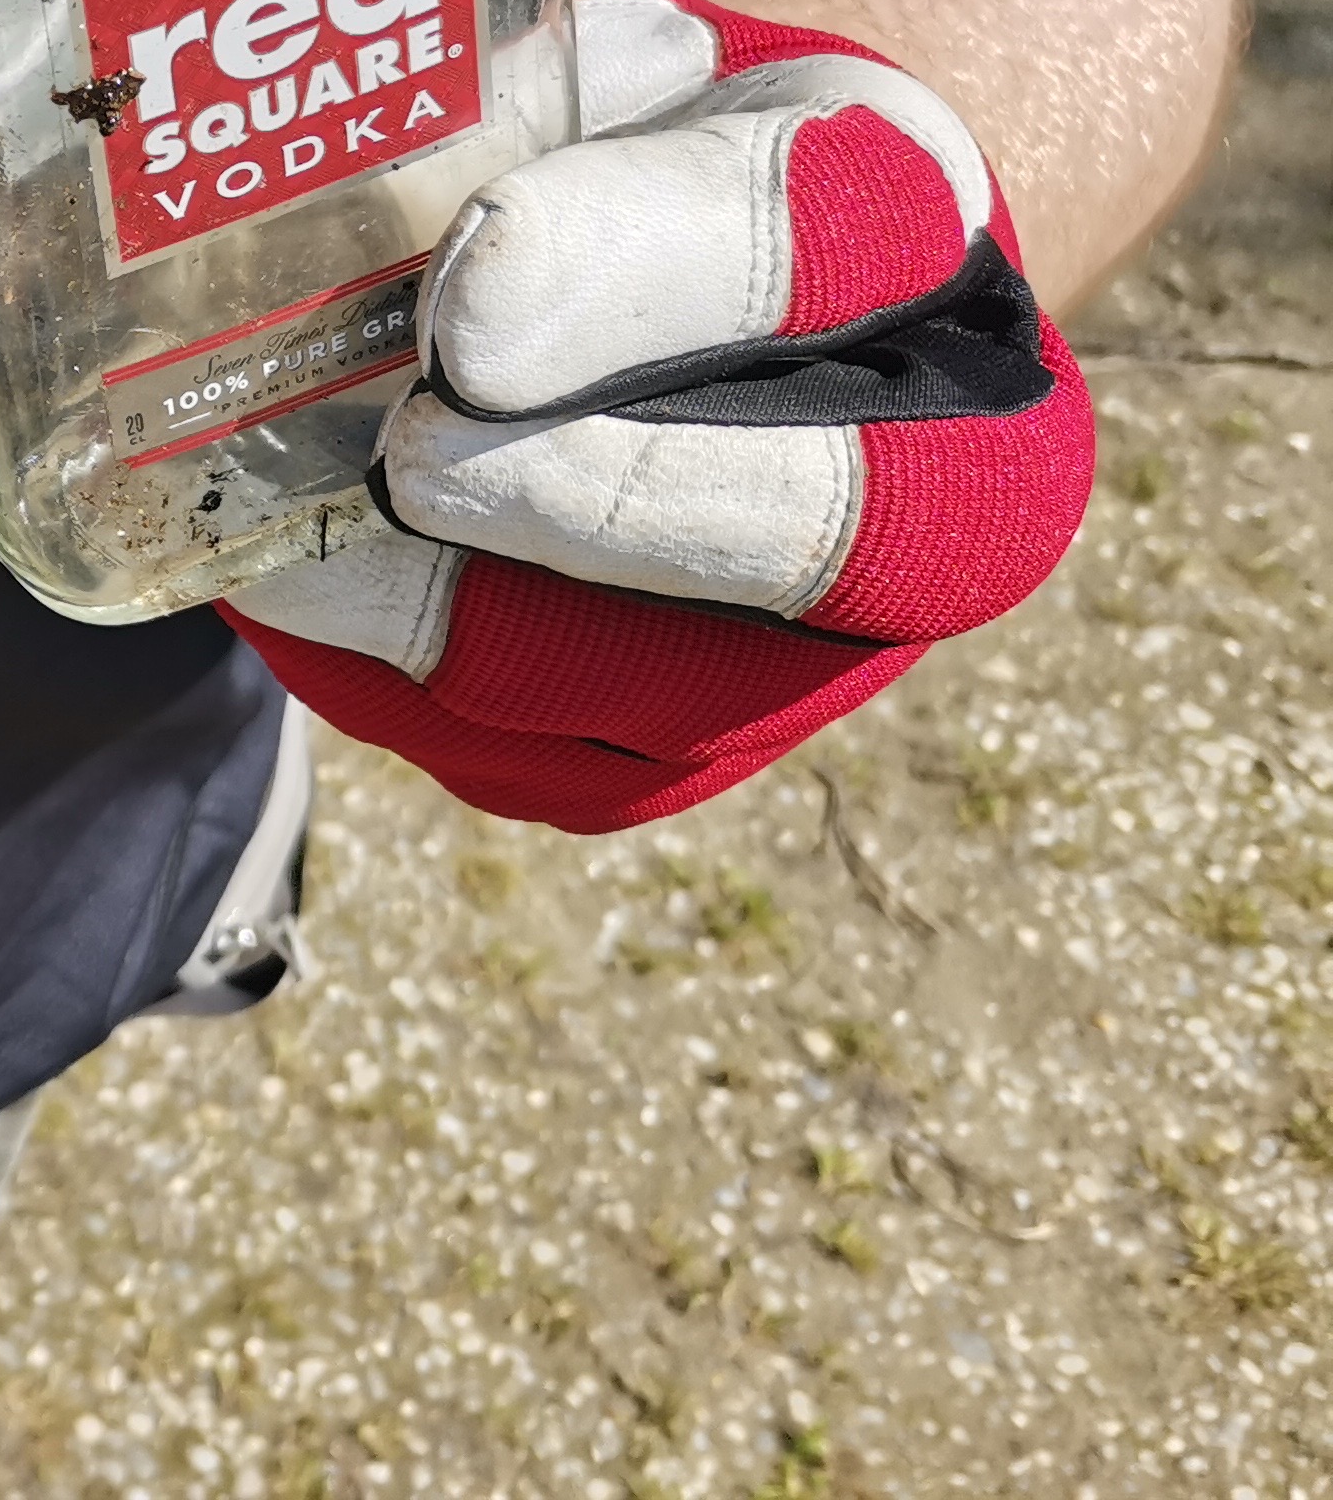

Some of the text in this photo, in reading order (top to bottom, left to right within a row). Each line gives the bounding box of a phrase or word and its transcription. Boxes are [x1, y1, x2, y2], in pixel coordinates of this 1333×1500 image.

[152, 89, 447, 221] VODKA
[162, 310, 417, 417] 100% PURE GR
[193, 354, 254, 385] Seven
[221, 366, 324, 414] PREMIUM
[125, 412, 145, 437] 20
[129, 435, 147, 446] CL
